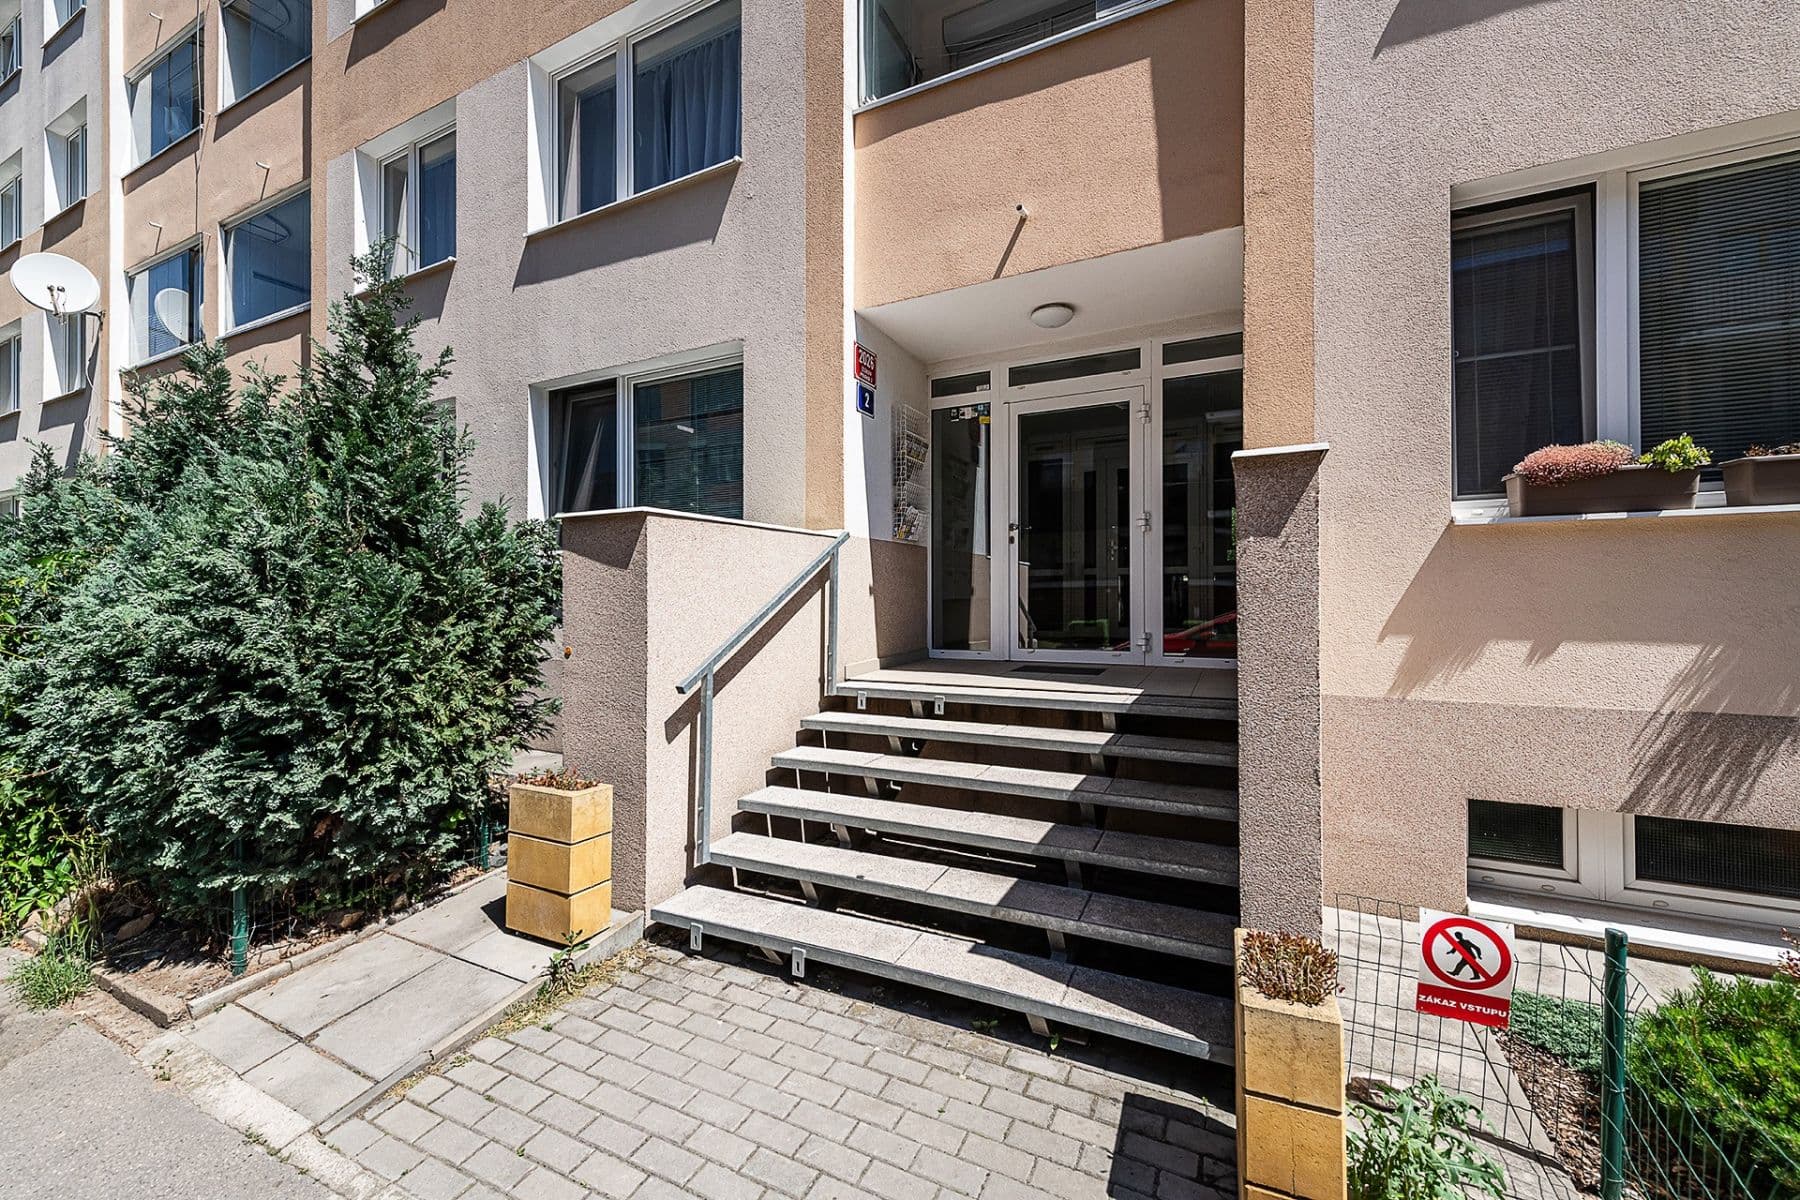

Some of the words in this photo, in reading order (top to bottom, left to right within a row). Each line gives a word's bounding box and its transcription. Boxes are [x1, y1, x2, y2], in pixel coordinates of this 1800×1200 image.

[865, 392, 870, 408] 2
[1418, 994, 1457, 1008] ZÁKAZ
[1460, 1002, 1507, 1017] VSTUPU
